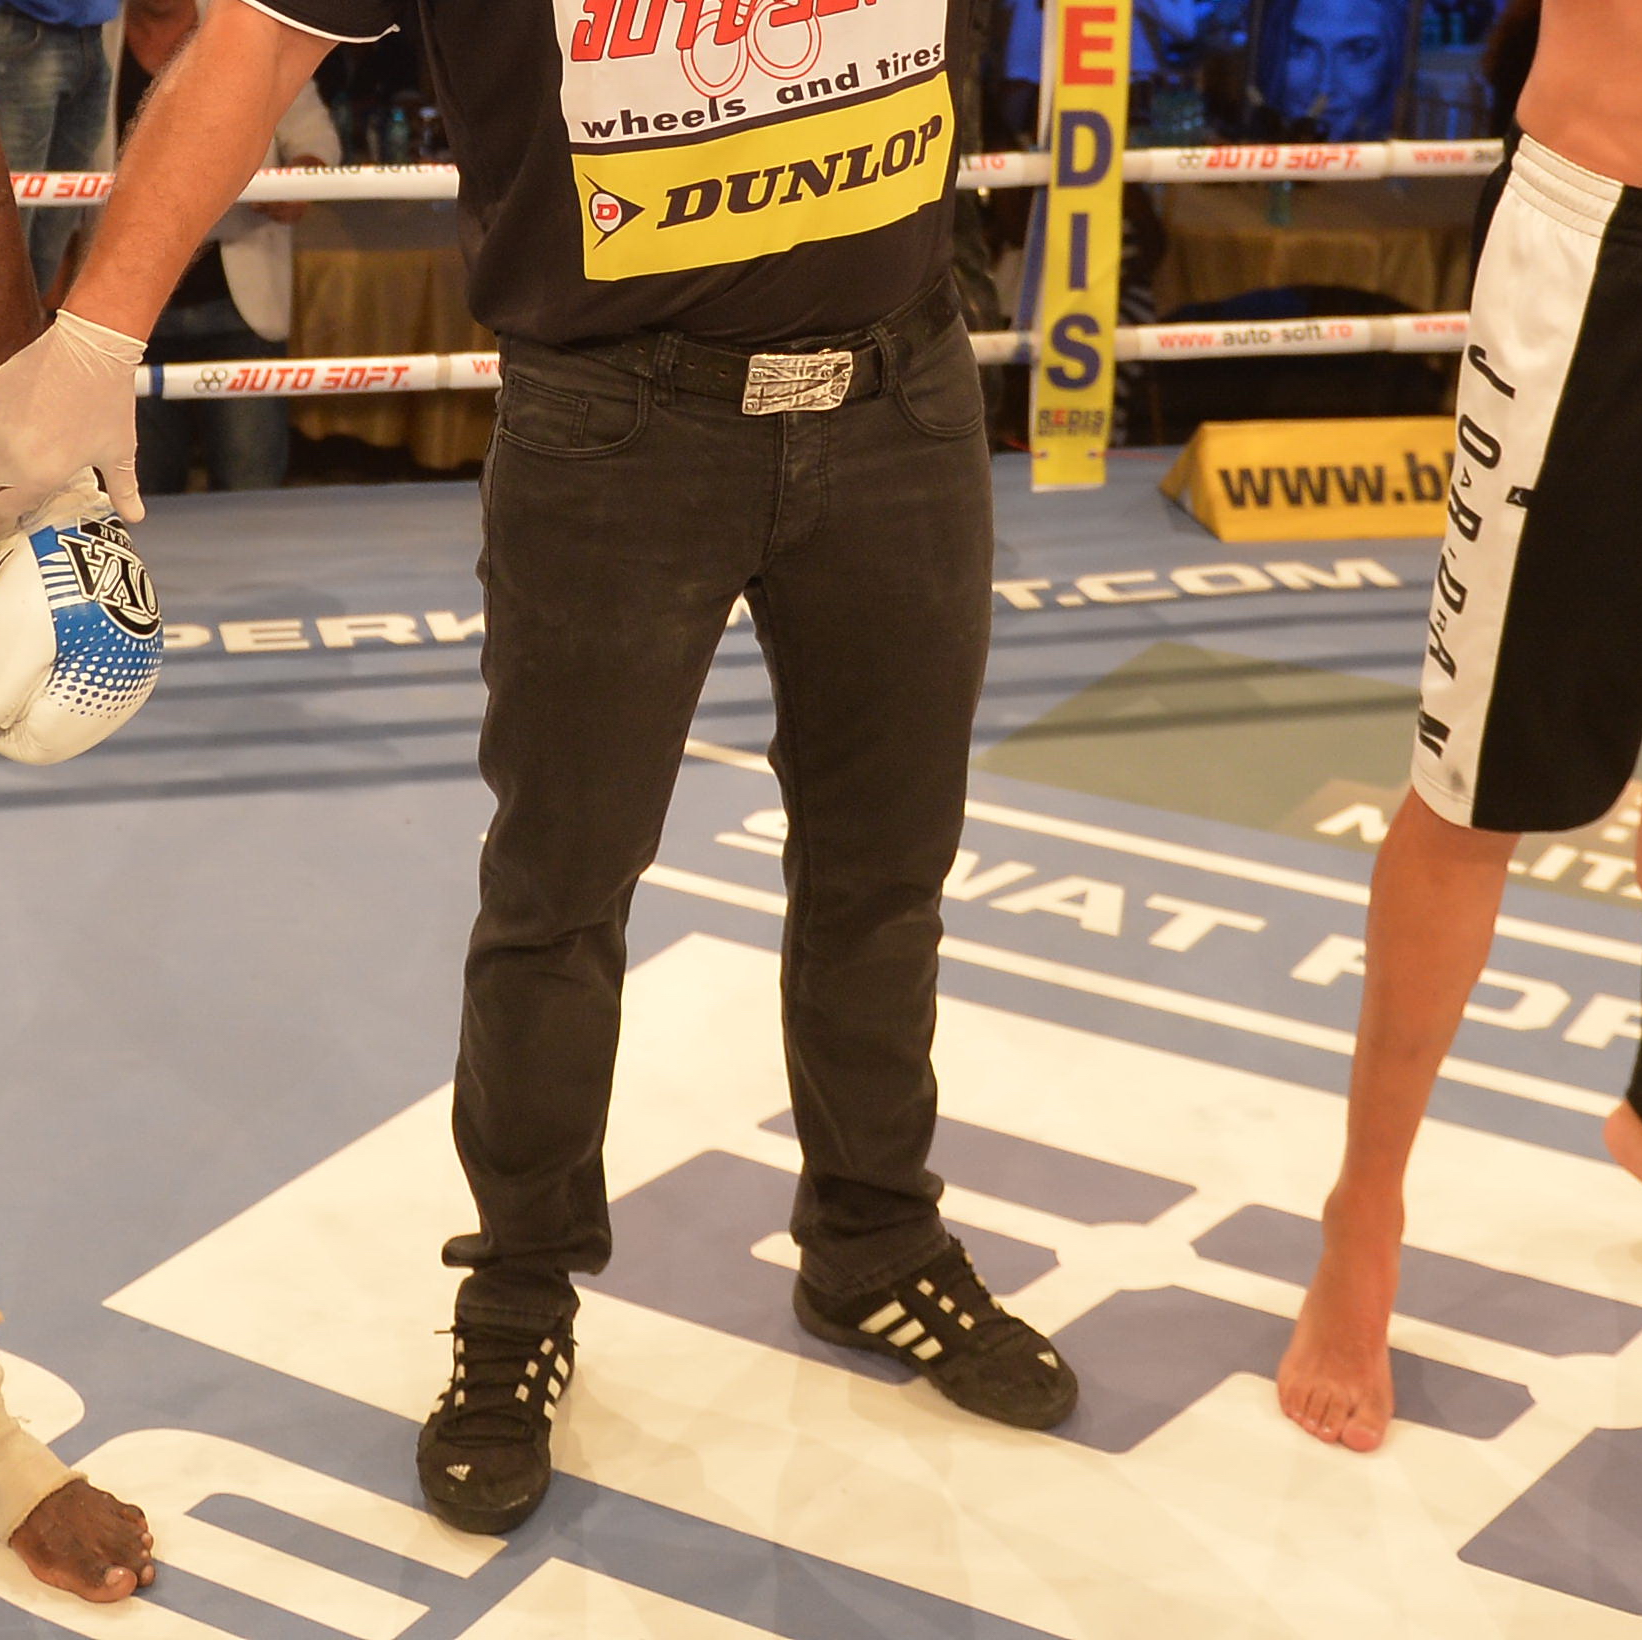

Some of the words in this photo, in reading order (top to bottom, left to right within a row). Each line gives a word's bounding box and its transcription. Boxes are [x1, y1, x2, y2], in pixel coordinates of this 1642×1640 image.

[581, 96, 747, 139] wheels
[776, 63, 860, 104] and
[876, 42, 942, 80] tires
[656, 115, 943, 230] DUNLOP
[1206, 145, 1280, 171] AUTO
[1158, 321, 1353, 349] www.auto-soft.ro
[227, 368, 314, 392] AUTO
[322, 365, 409, 390] SOFT
[57, 534, 159, 620] OYA
